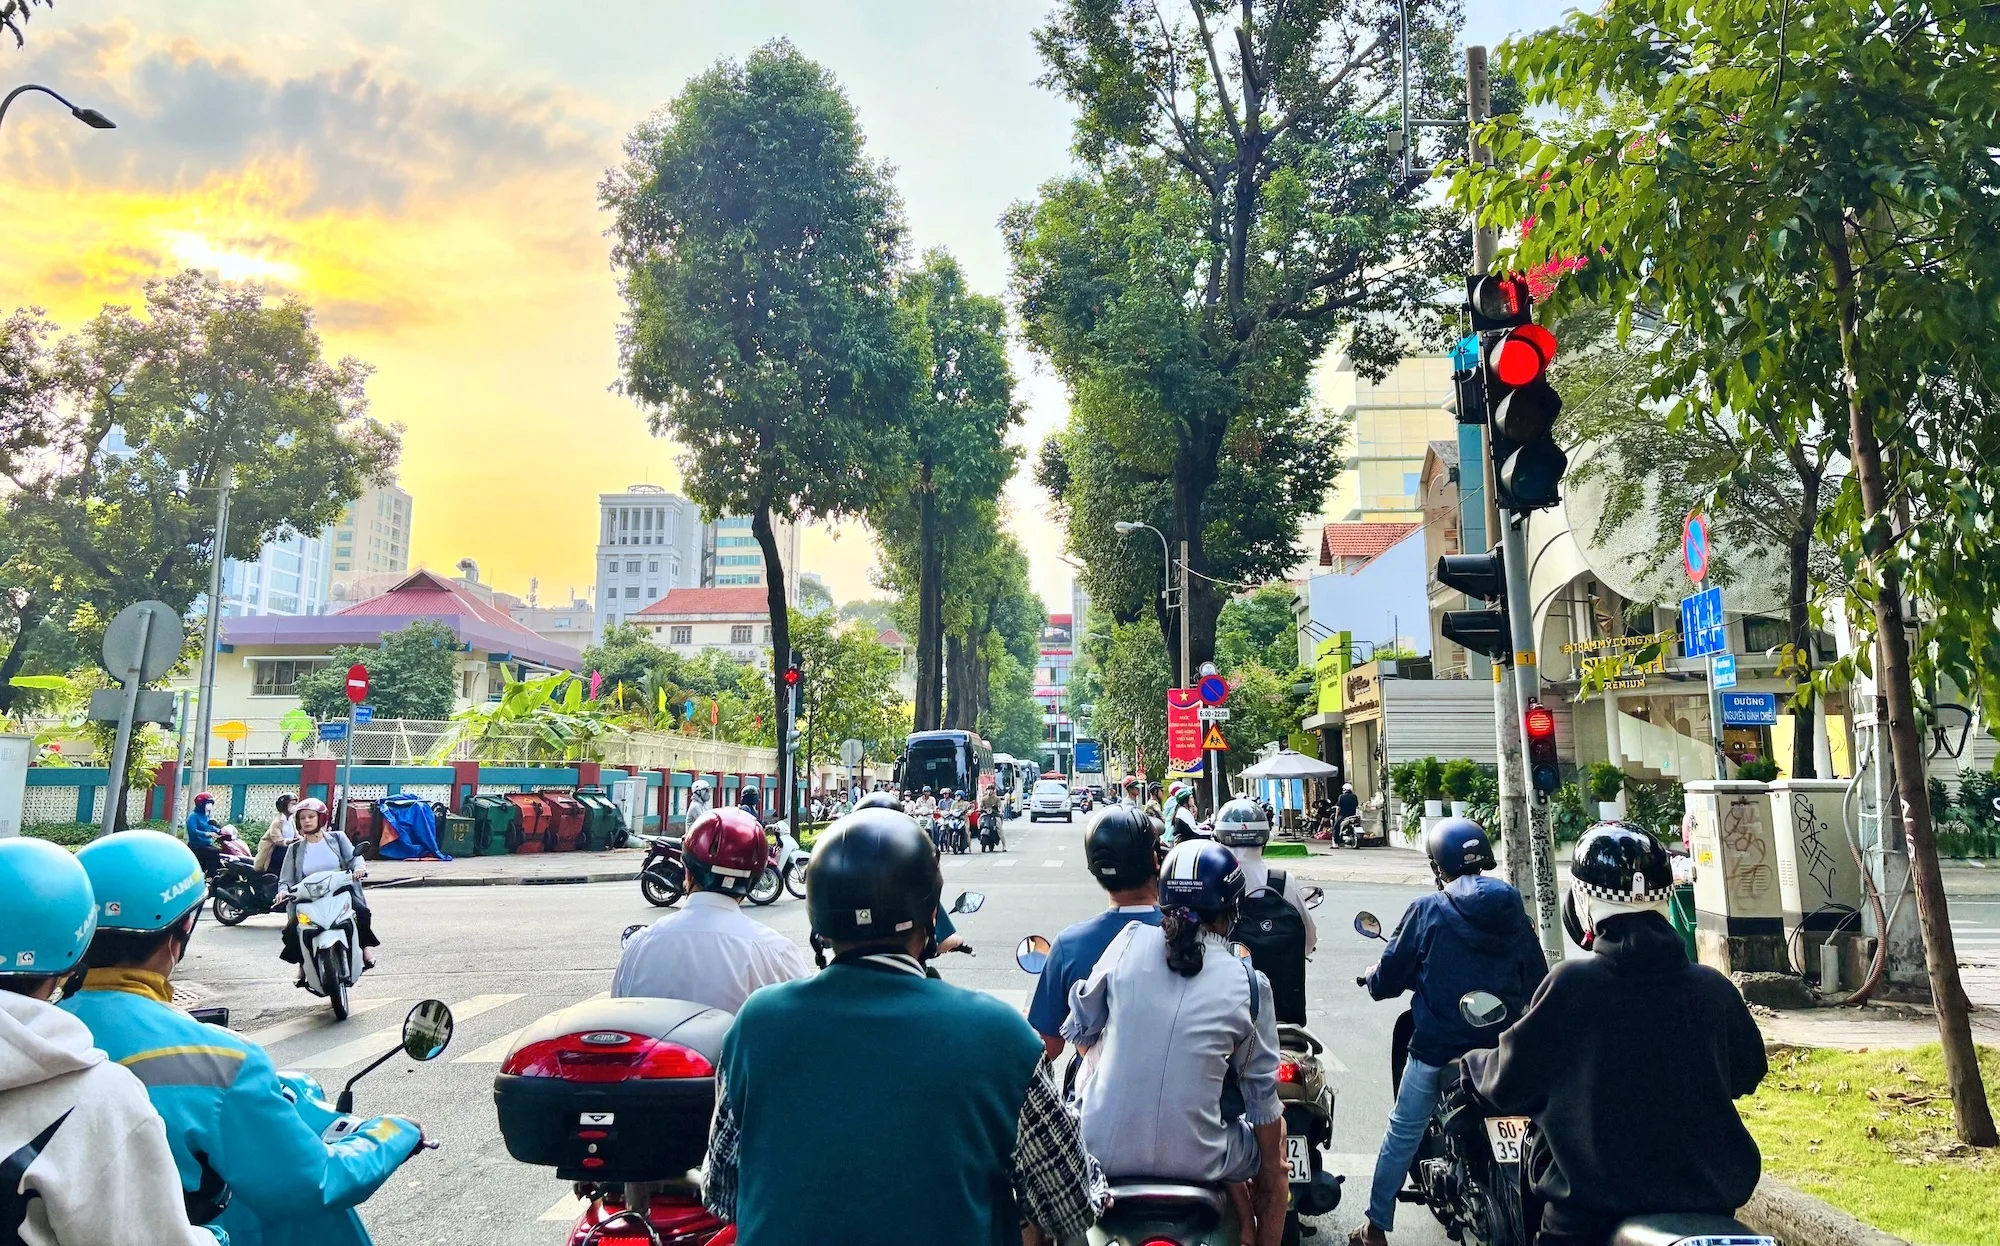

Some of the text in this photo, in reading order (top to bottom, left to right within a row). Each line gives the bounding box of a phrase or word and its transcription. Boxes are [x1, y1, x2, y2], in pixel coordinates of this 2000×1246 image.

[1733, 696, 1765, 706] ĐƯỜNG
[1747, 709, 1760, 721] ĐÌNH
[160, 875, 194, 904] XANH
